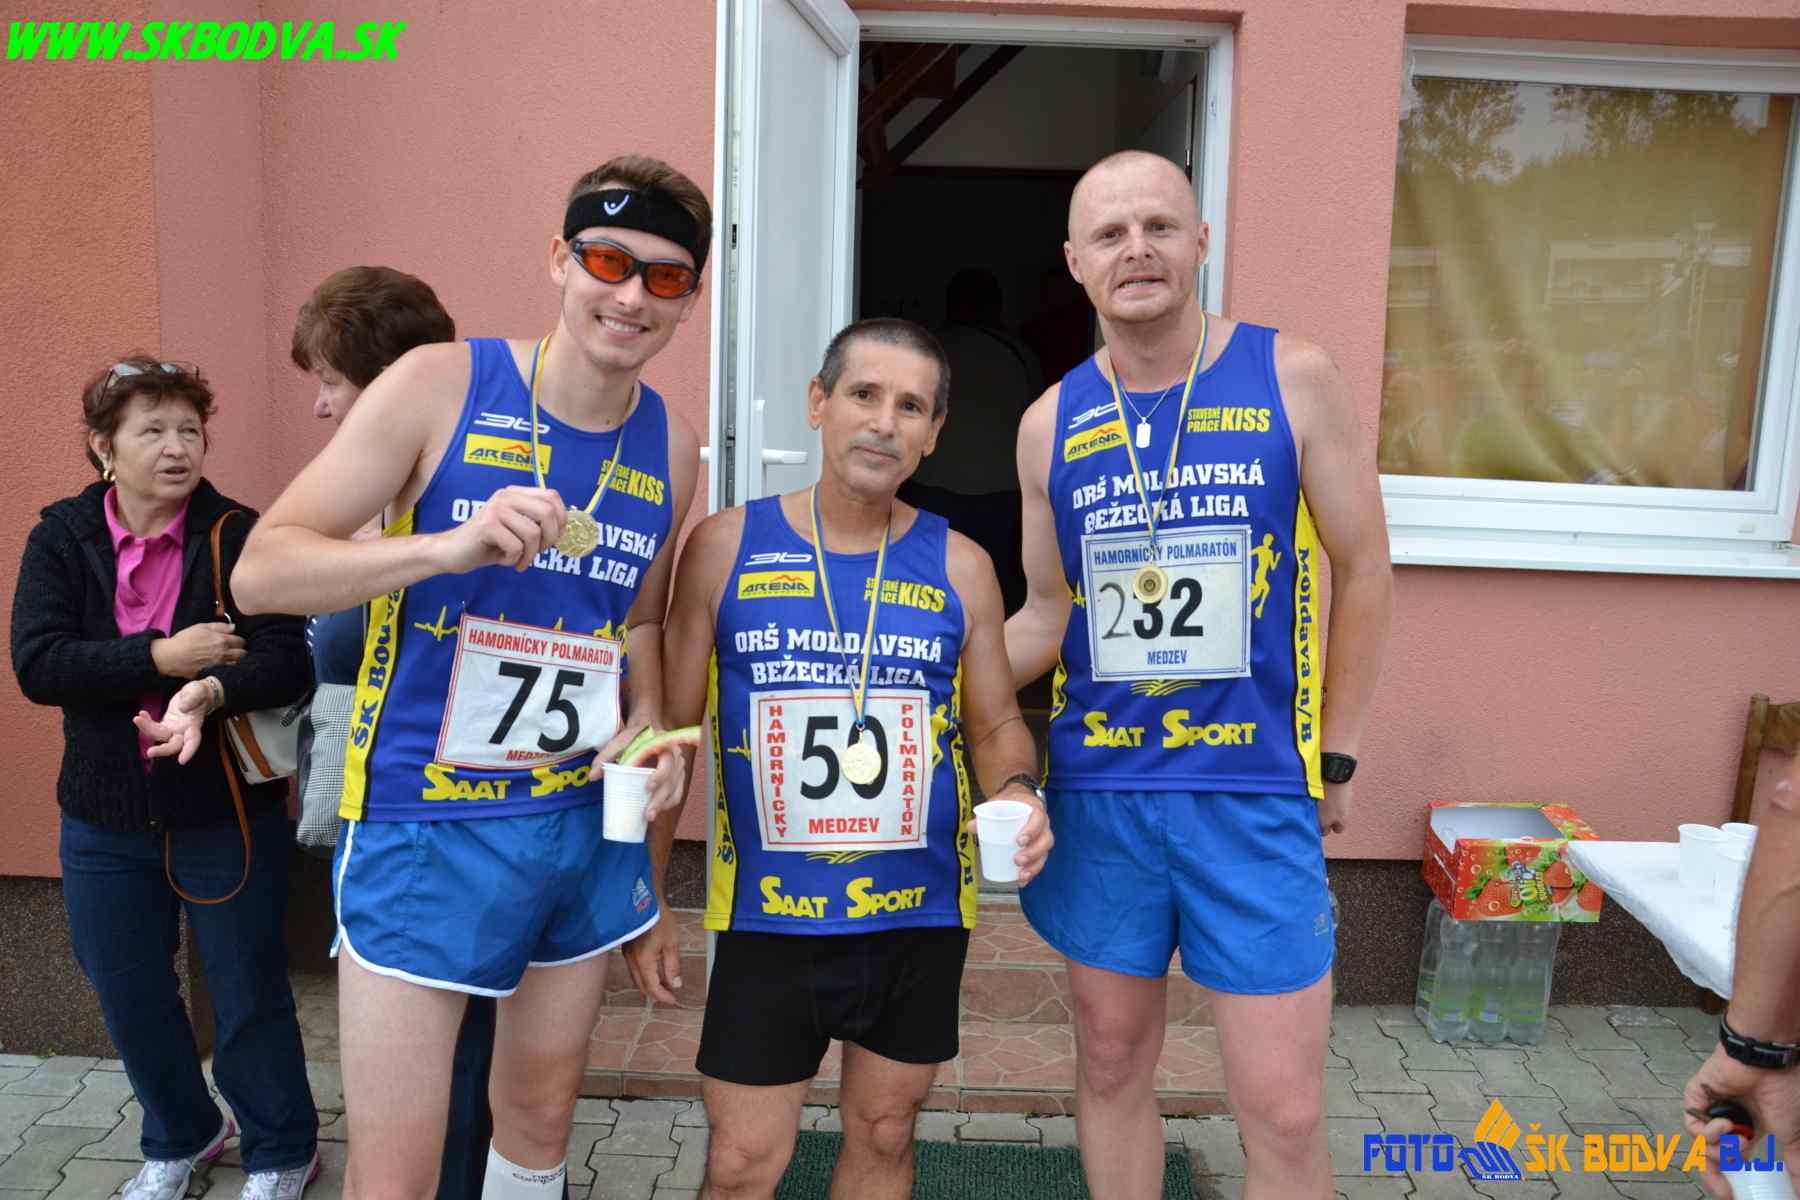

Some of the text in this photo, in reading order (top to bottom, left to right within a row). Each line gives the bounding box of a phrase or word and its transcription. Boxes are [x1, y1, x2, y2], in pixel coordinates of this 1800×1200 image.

[1220, 406, 1271, 433] KISS
[1067, 432, 1122, 456] ARENA
[627, 468, 665, 506] KISS
[1071, 474, 1107, 510] ORŠ
[1190, 493, 1250, 518] LIGA
[588, 555, 639, 589] LIGA
[742, 581, 810, 594] ARENA
[898, 581, 947, 613] KISS
[1098, 577, 1204, 640] 232
[734, 621, 780, 653] ORŠ
[750, 653, 927, 688] BEŽECKÁ LIGA
[1146, 649, 1188, 665] MEDZEV
[487, 660, 585, 753] 75
[1161, 708, 1257, 749] SPORT
[799, 714, 889, 800] 50
[421, 762, 511, 801] SAAT
[808, 817, 880, 834] MEDZEV
[759, 875, 927, 919] SAAT SPORT
